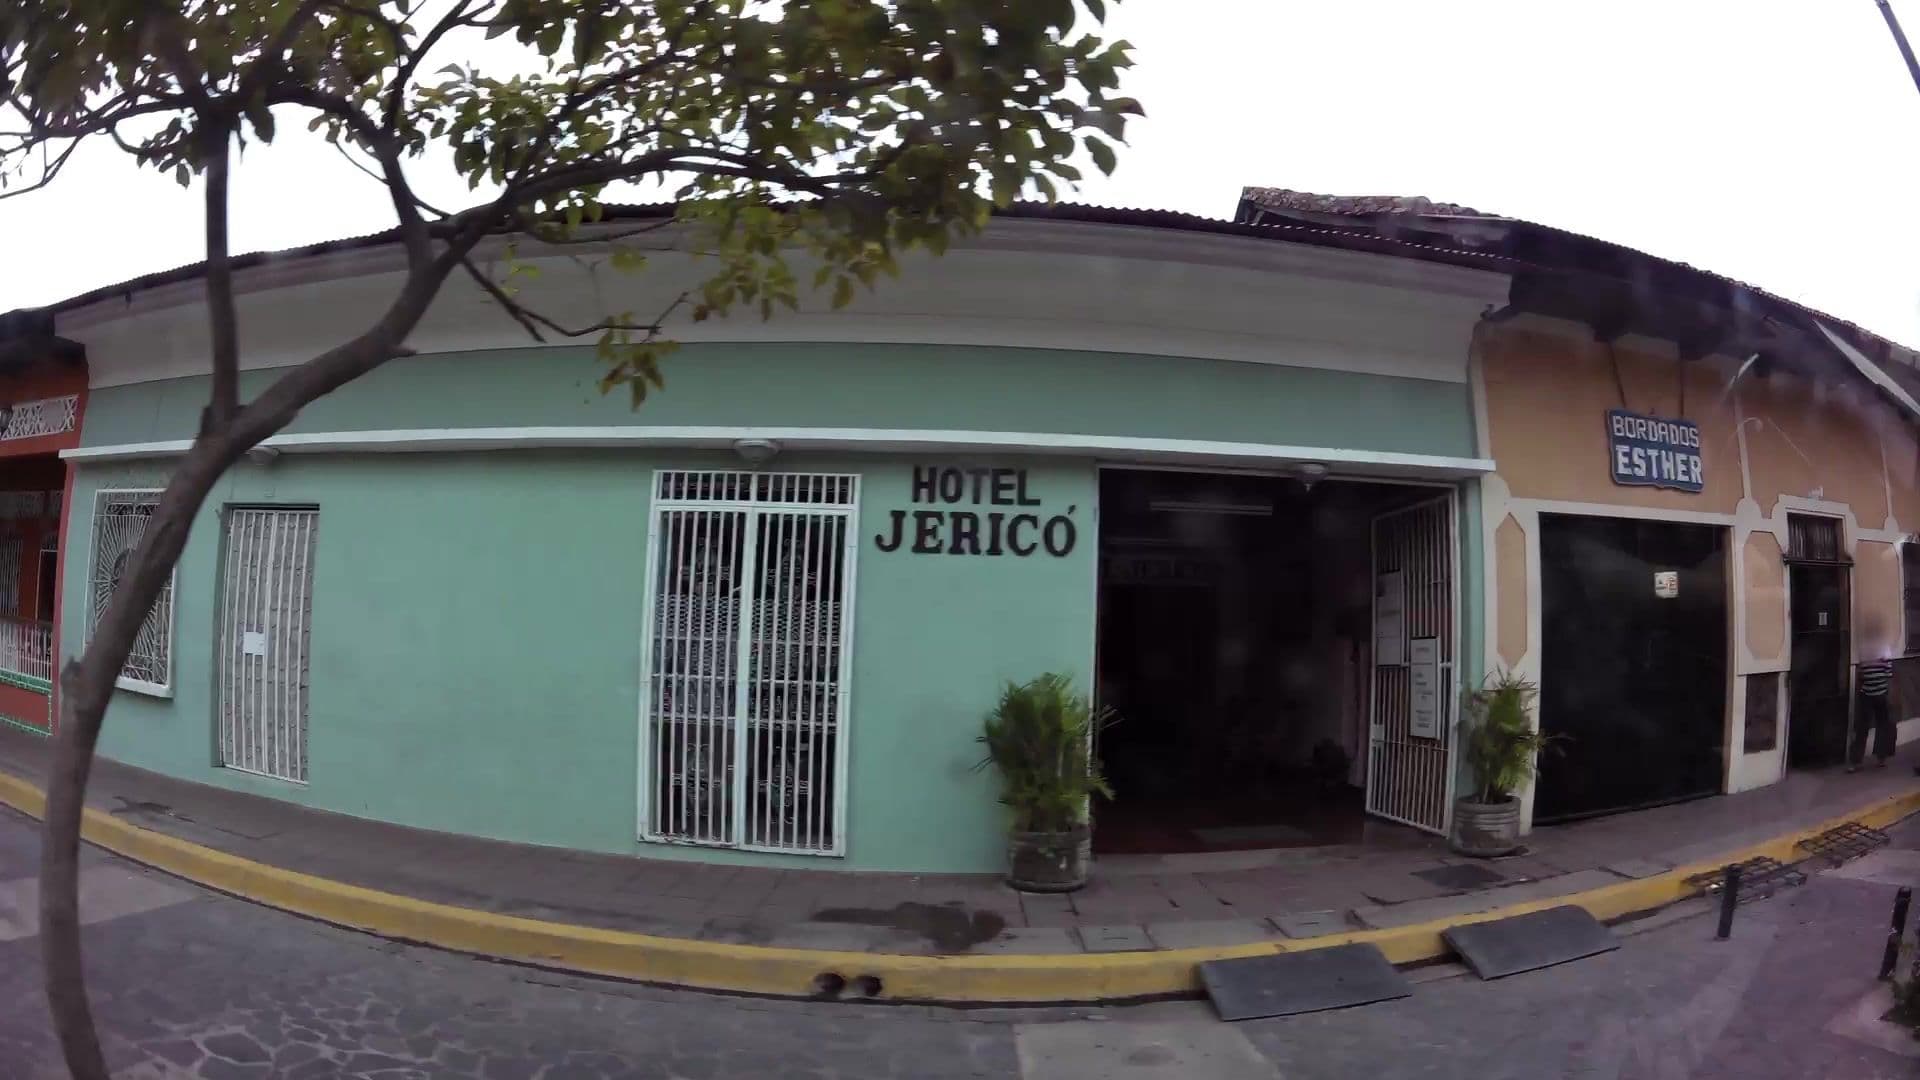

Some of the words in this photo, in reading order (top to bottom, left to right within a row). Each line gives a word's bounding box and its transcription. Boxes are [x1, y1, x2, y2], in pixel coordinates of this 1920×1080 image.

[1612, 415, 1699, 448] BORDADOS
[1615, 444, 1703, 483] ESTHER
[912, 466, 1040, 505] HOTEL
[875, 504, 1076, 557] JERICÓ
